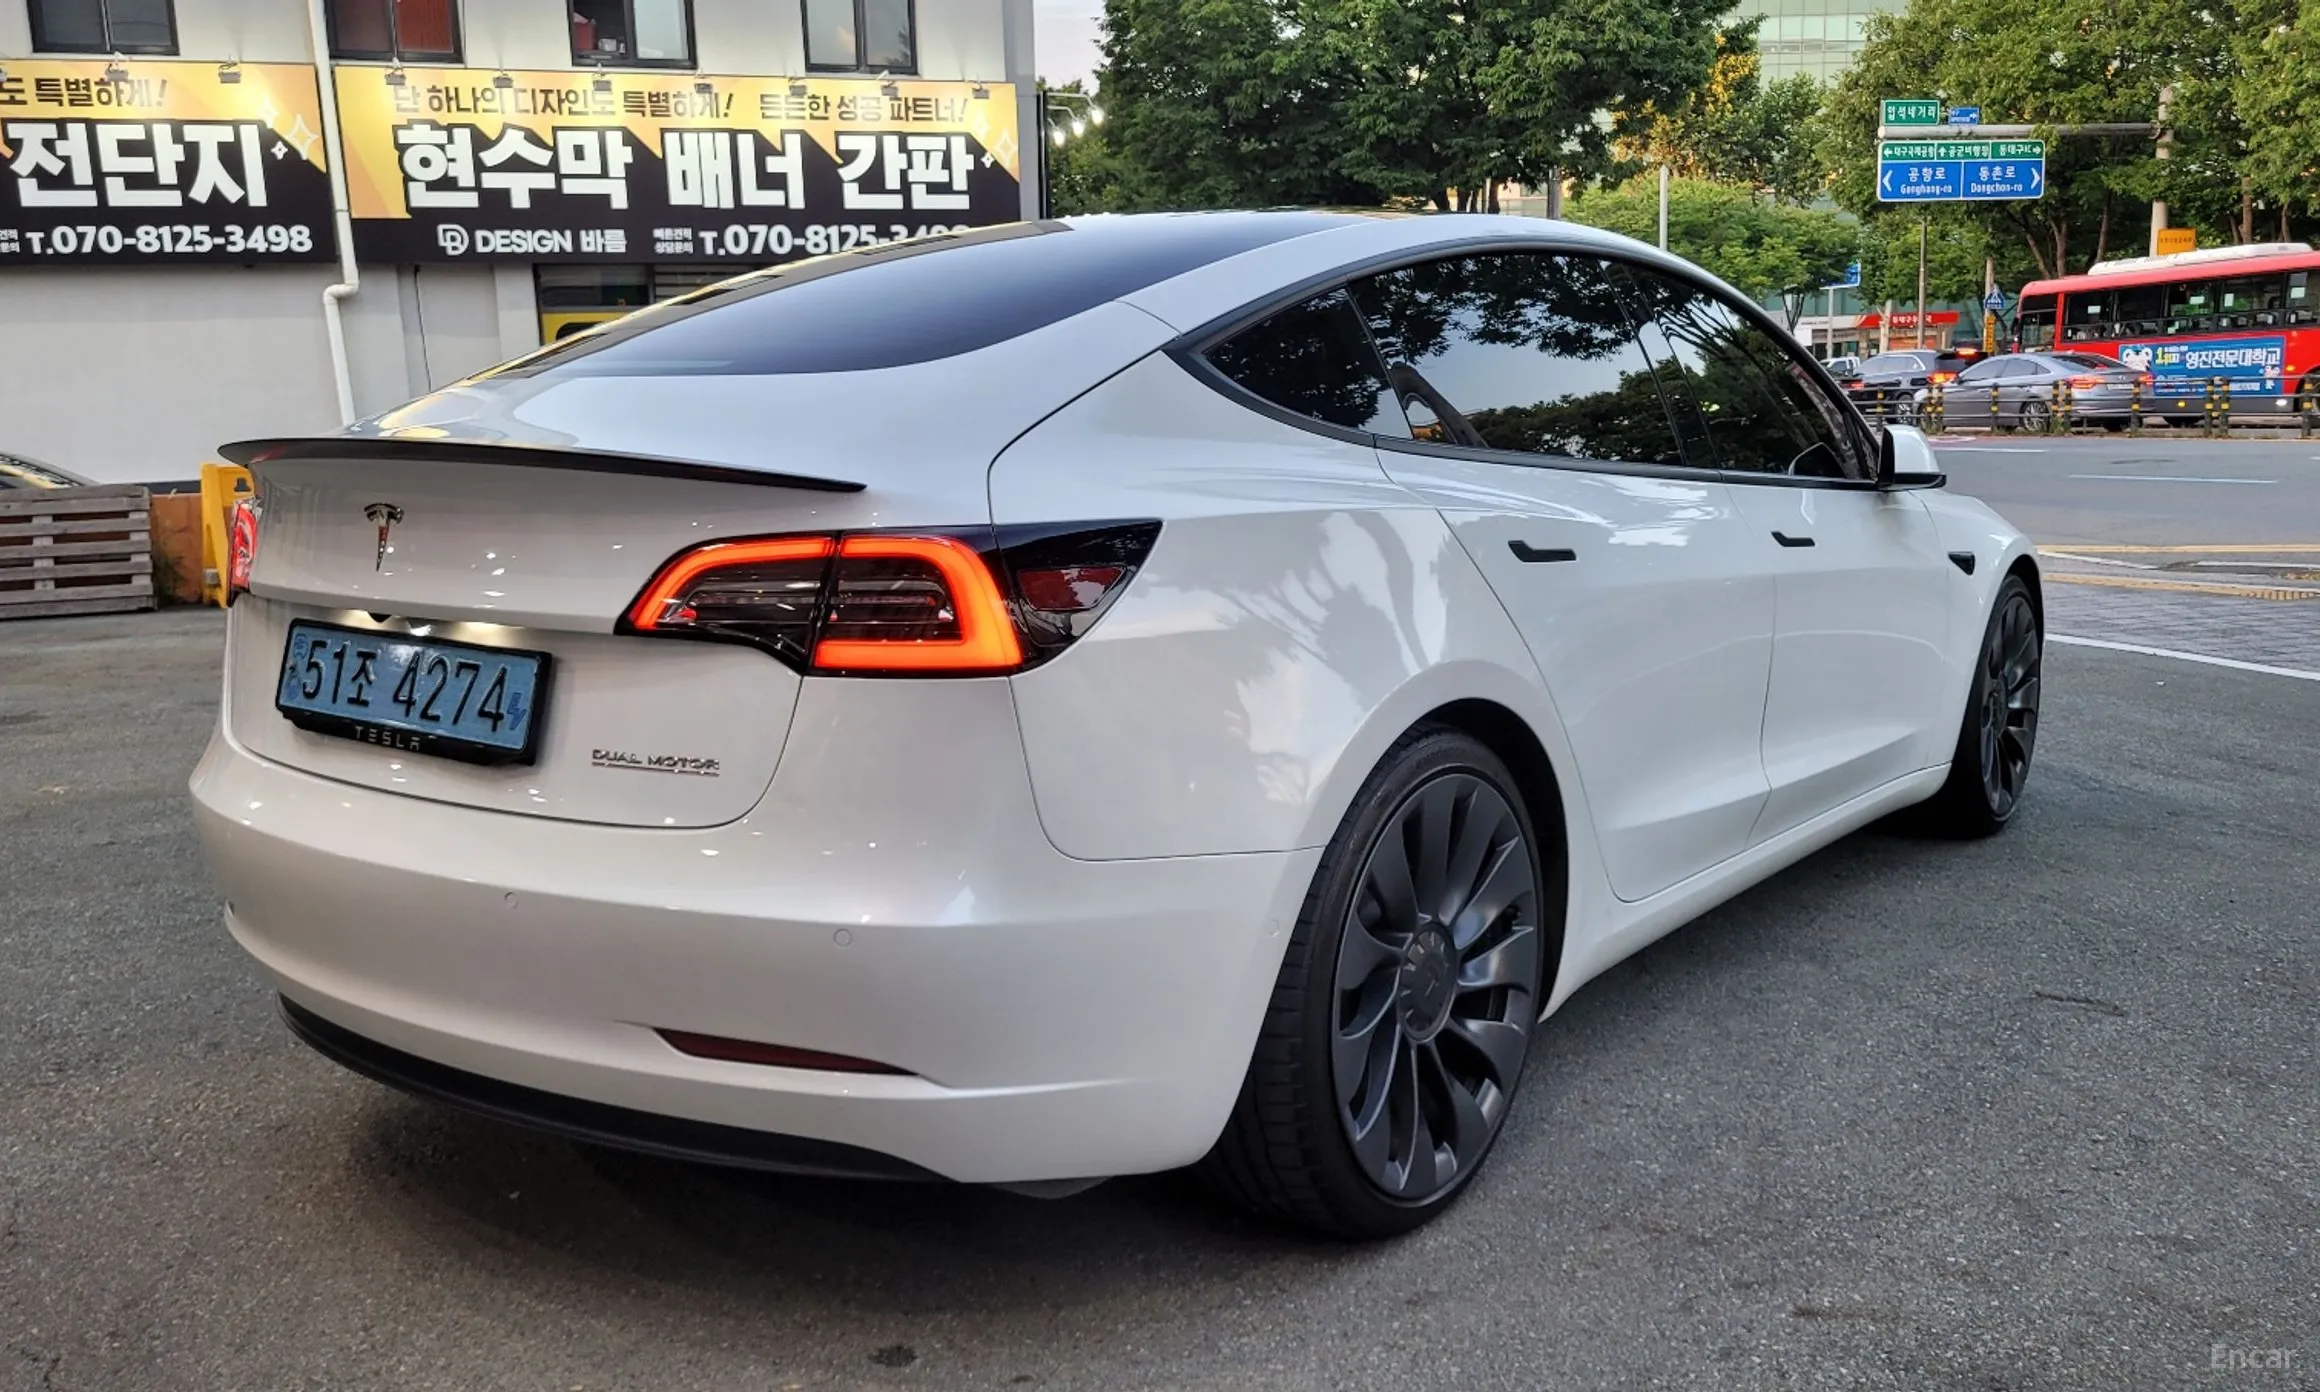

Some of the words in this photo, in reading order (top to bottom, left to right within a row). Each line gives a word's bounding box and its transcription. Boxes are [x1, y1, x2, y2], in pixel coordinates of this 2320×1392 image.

[0, 77, 27, 105] 도
[34, 77, 167, 107] 특별하게!
[394, 85, 420, 113] 단
[427, 85, 505, 114] 하나의
[514, 88, 616, 116] 디자인도
[623, 90, 733, 119] 특별하게!
[760, 93, 830, 121] 든든한
[837, 95, 882, 121] 성공
[889, 97, 968, 122] 파트너!
[1887, 105, 1936, 121] 입석네거리
[7, 123, 267, 207] 전단지
[397, 124, 633, 209] 현수막
[664, 131, 806, 209] 배너
[837, 134, 974, 210] 간판
[1908, 167, 1946, 182] 공항로
[1979, 166, 2016, 181] 동촌로
[1971, 182, 2022, 195] Dongchon-ro
[25, 225, 313, 255] T.070-8125-3498
[475, 229, 573, 253] DESIGN
[580, 229, 627, 253] 바름
[2186, 349, 2280, 369] 영진전문대학교
[302, 640, 377, 707] 51조
[393, 651, 508, 732] 4274
[355, 726, 420, 751] TESLA
[592, 749, 642, 765] DUAL
[648, 755, 720, 770] MOTOR
